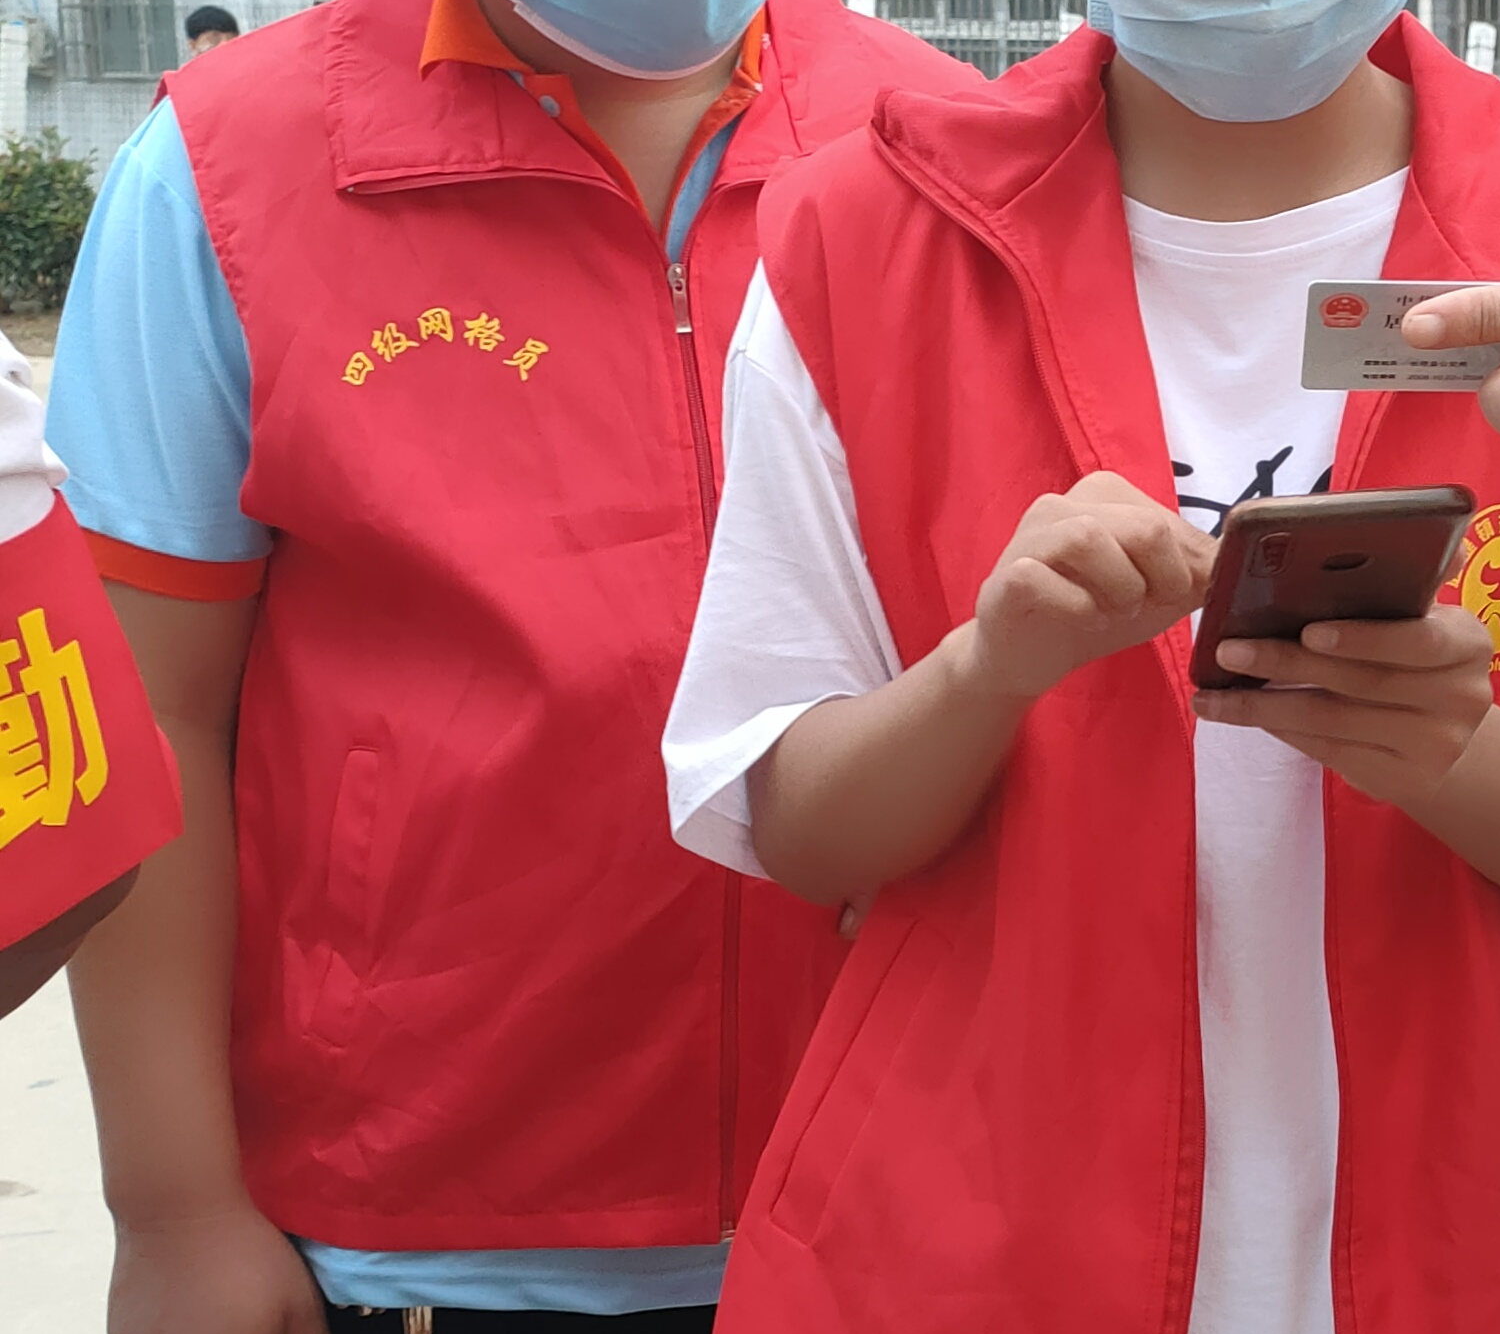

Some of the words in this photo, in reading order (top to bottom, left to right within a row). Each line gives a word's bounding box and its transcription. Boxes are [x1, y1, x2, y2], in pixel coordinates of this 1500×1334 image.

[341, 307, 549, 386] 四级网格员
